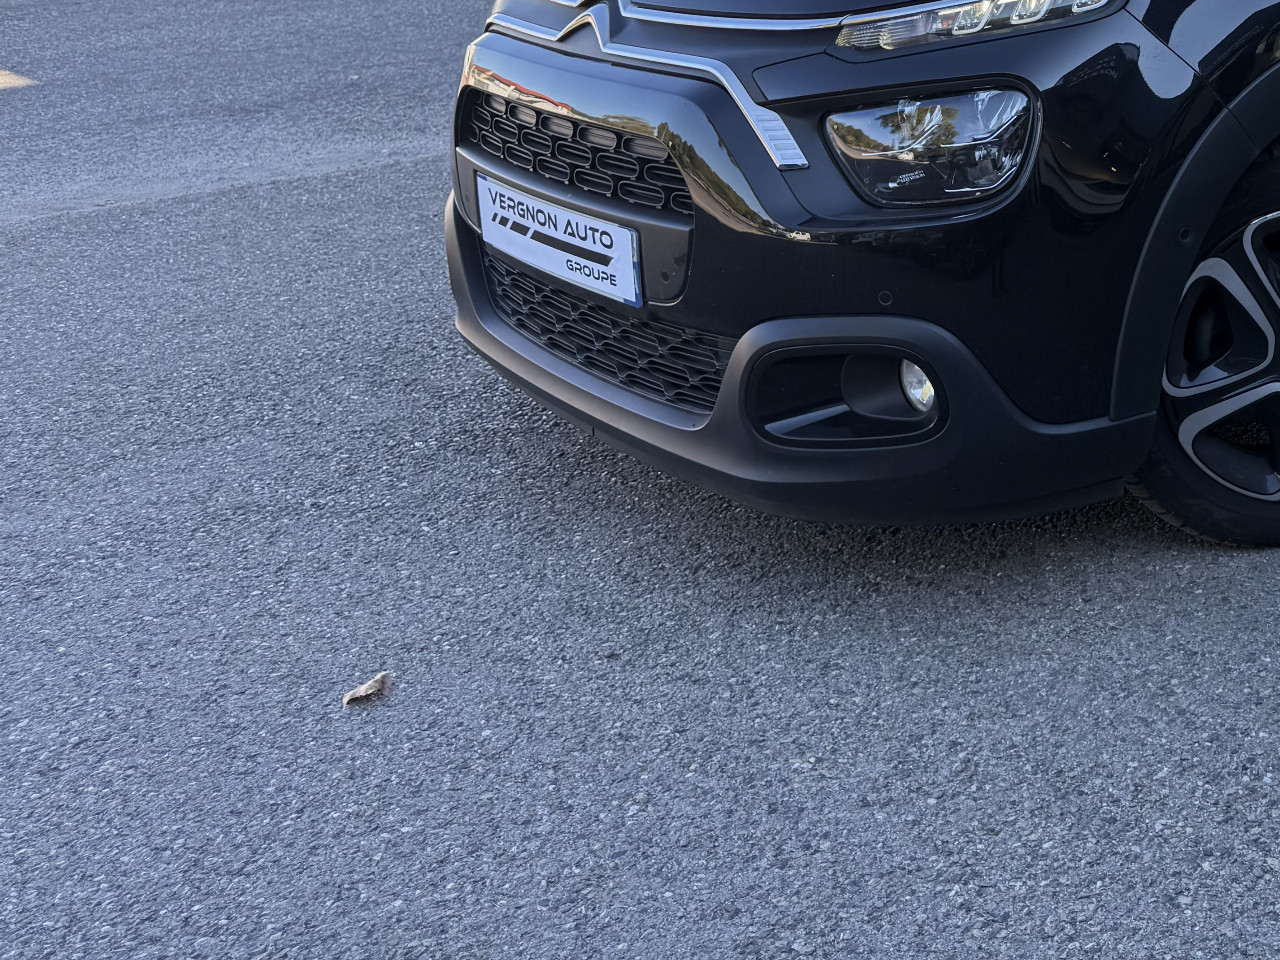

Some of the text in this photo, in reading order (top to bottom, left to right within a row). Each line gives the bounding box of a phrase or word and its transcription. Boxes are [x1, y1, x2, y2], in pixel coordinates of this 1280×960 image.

[488, 188, 614, 250] VERGNON AUTO
[566, 259, 617, 287] GROUPE
